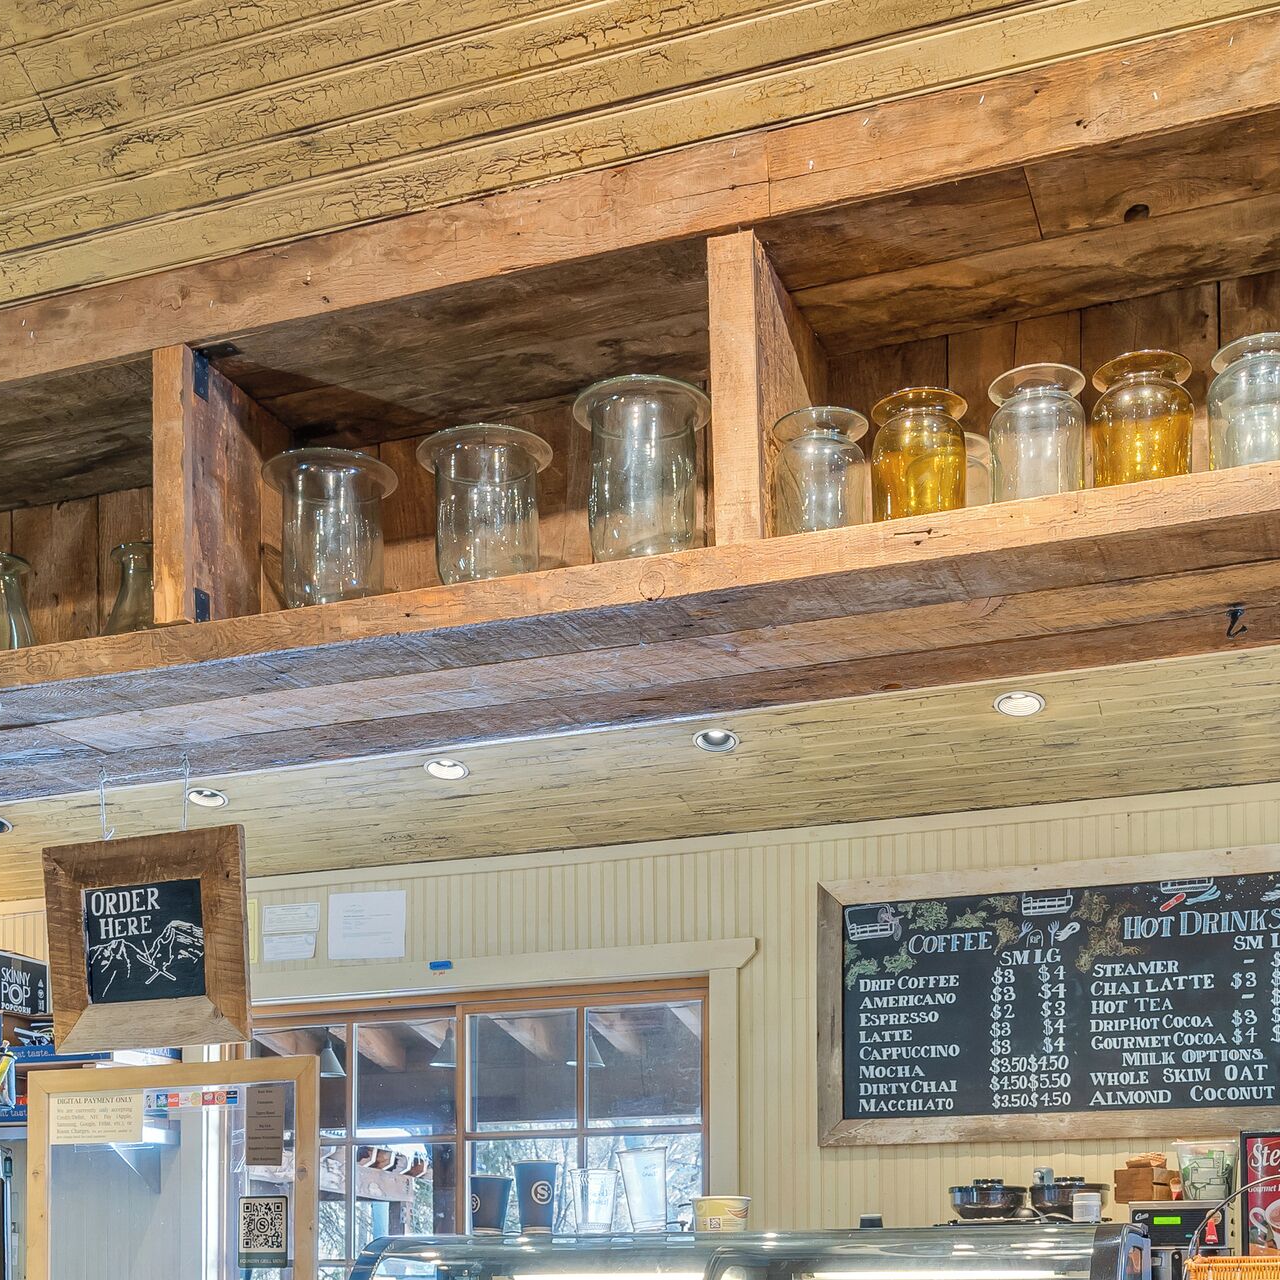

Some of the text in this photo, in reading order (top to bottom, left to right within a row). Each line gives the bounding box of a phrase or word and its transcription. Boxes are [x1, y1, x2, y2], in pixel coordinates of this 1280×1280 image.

[91, 886, 161, 917] ORDER
[99, 915, 152, 940] HERE
[1123, 915, 1175, 940] HOT
[908, 932, 992, 954] COFFEE
[1233, 934, 1264, 950] SM
[1000, 948, 1062, 966] SM LG
[1, 967, 31, 986] SKINNY
[859, 965, 1066, 992] DRIP COFFEE $3 $4
[1093, 960, 1179, 977] STEAMER
[1, 982, 31, 1006] POP
[1091, 980, 1140, 996] CHAI
[1145, 974, 1215, 992] LATTE
[1231, 972, 1257, 989] $3
[859, 983, 1067, 1009] AMERICANO $3 $4
[1091, 1000, 1129, 1015] HOT
[1134, 998, 1173, 1012] TEA
[1, 1002, 31, 1014] POPCORN
[859, 1001, 1066, 1027] ESPRESSO $2 $3
[1162, 1014, 1213, 1028] COCOA
[1232, 1009, 1258, 1027] $3
[859, 1018, 1066, 1043] LATTE $3 $4
[1091, 1035, 1171, 1050] GOURMET
[1173, 1031, 1226, 1046] COCOA
[1232, 1026, 1258, 1045] $4
[859, 1037, 1065, 1060] CAPPUCCINO $3 $4
[1122, 1049, 1264, 1067] MILK OPTIONS
[859, 1065, 926, 1079] MOCHA
[1090, 1065, 1268, 1086] WHOLE SKIM OAT
[859, 1080, 957, 1096] DIRTY CHAI
[1089, 1086, 1276, 1106] ALMOND COCONUT
[859, 1098, 954, 1113] MACCHIATO
